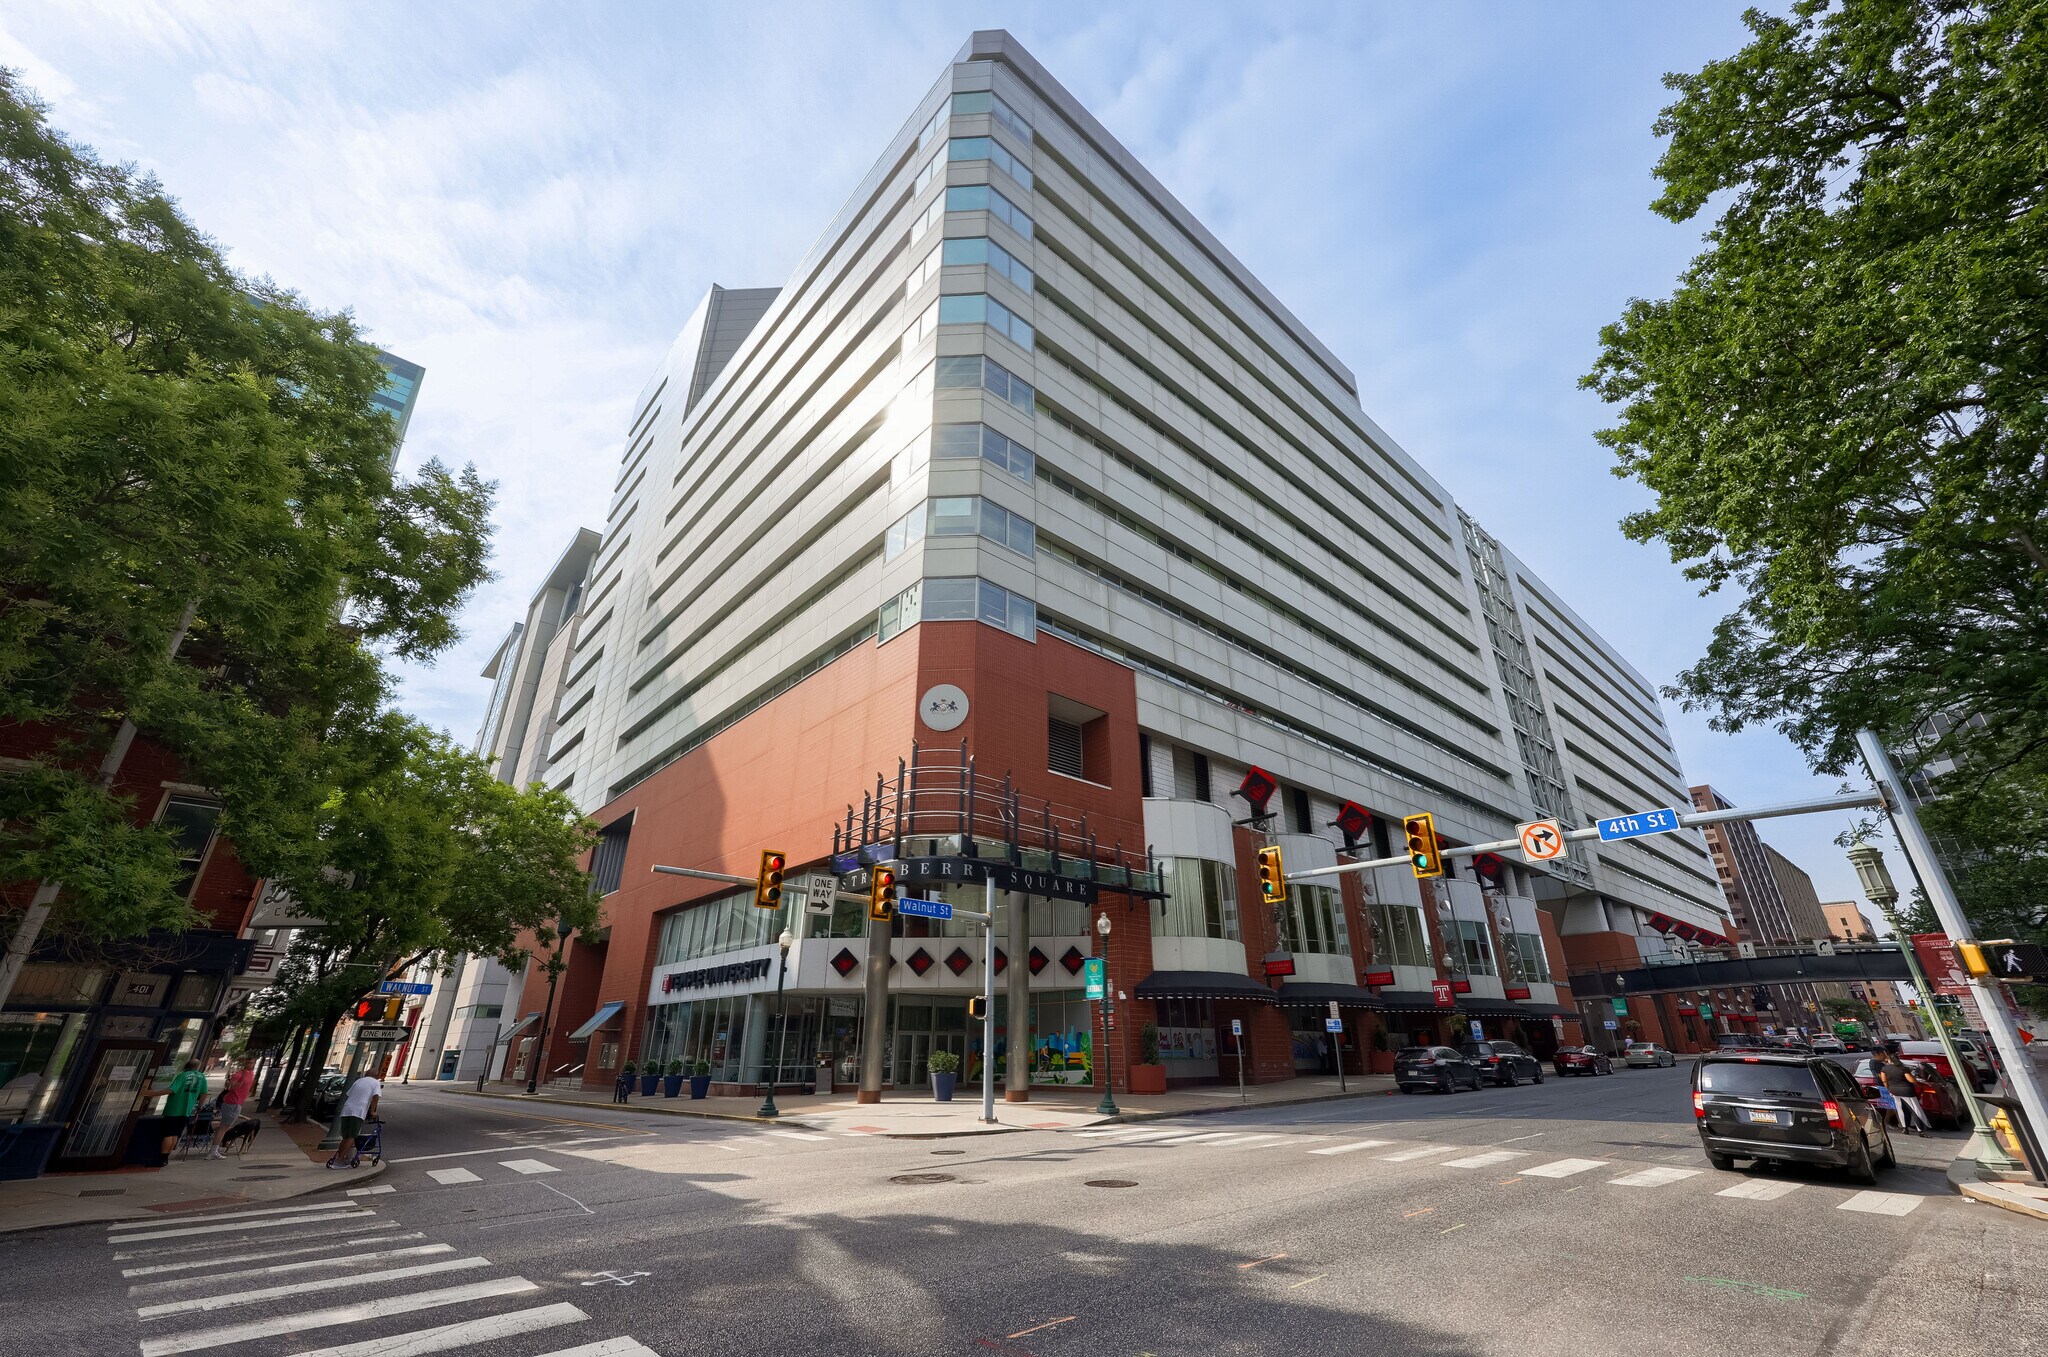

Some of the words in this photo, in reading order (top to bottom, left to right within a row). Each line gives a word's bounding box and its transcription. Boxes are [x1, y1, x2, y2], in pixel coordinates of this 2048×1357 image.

[1609, 818, 1640, 834] 4th
[1647, 813, 1667, 828] St
[814, 878, 832, 889] ONE
[1011, 871, 1088, 896] SQUARE
[813, 888, 832, 898] WAY
[903, 900, 936, 914] Walnut
[940, 905, 949, 916] St
[671, 968, 705, 992] TEMPLE
[705, 958, 772, 988] UNIVERSITY
[133, 985, 149, 993] 401
[386, 984, 418, 993] WALNUT
[1433, 984, 1450, 1002] T
